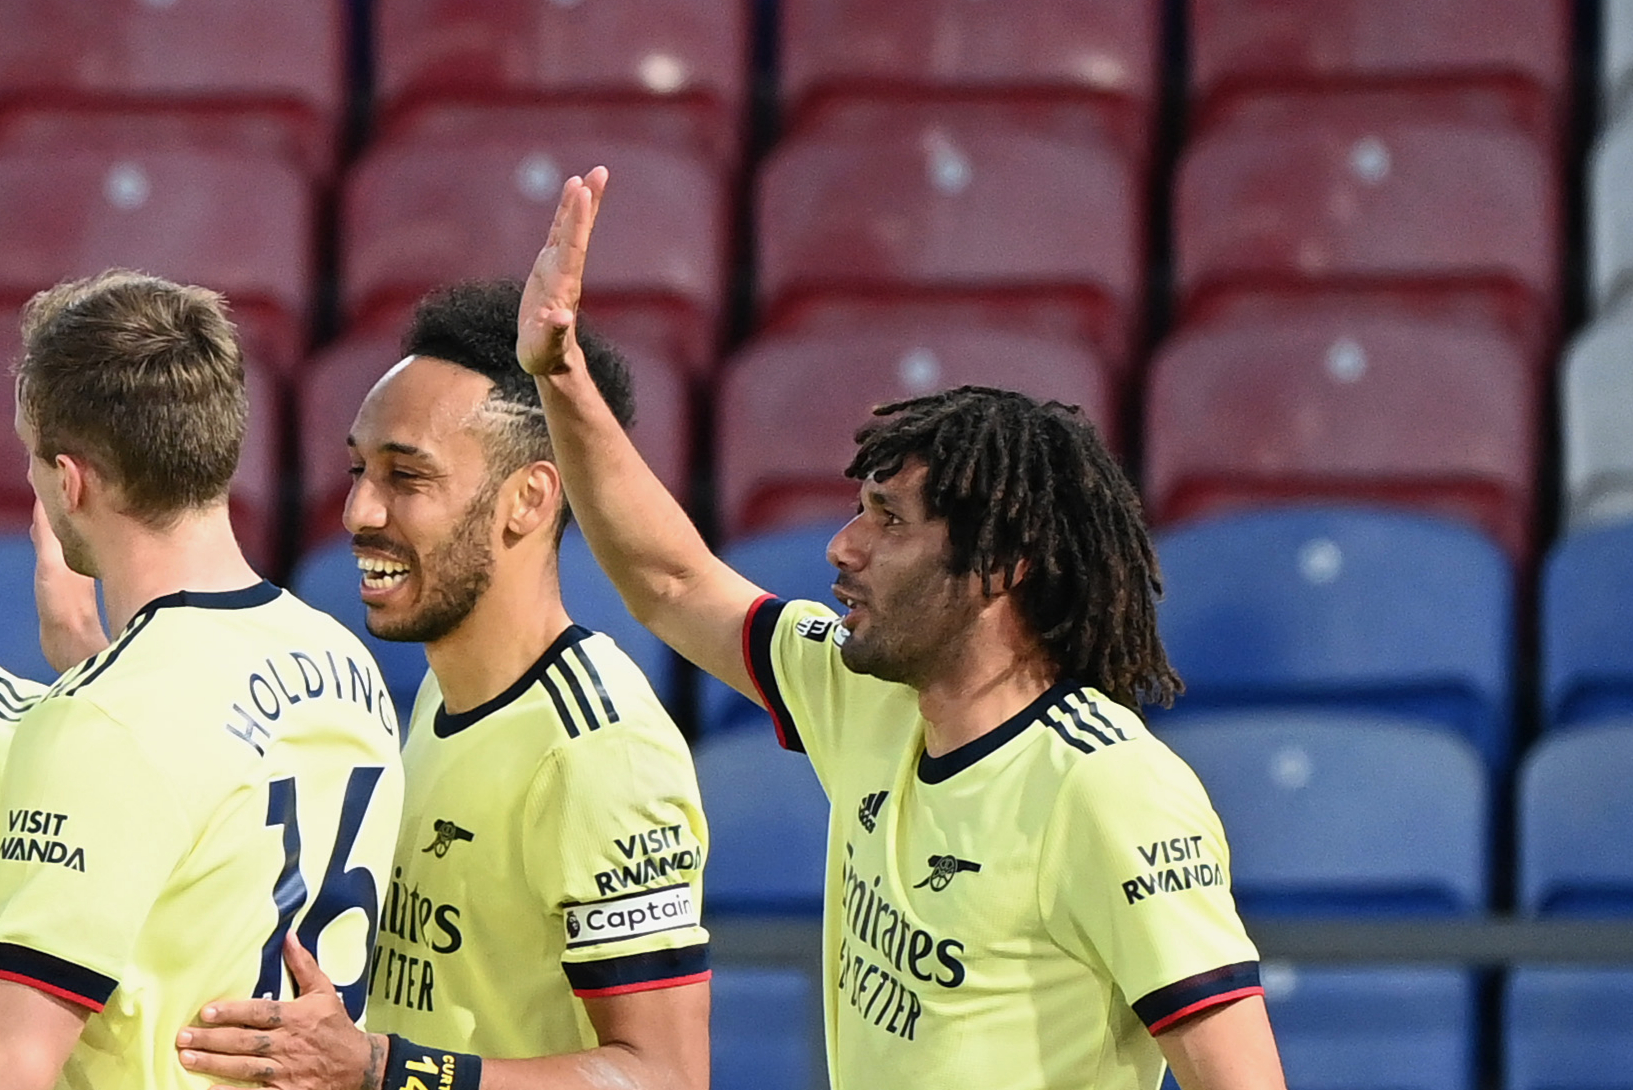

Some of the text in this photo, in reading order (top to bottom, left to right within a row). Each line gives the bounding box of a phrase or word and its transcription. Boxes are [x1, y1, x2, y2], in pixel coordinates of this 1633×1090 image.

[9, 809, 68, 837] VISIT
[613, 824, 682, 860] VISIT
[1137, 835, 1202, 867] VISIT
[594, 845, 702, 897] RWANDA
[1121, 863, 1224, 905] RWANDA
[251, 766, 385, 1024] 16
[585, 894, 693, 931] Captain
[843, 841, 966, 989] mirates
